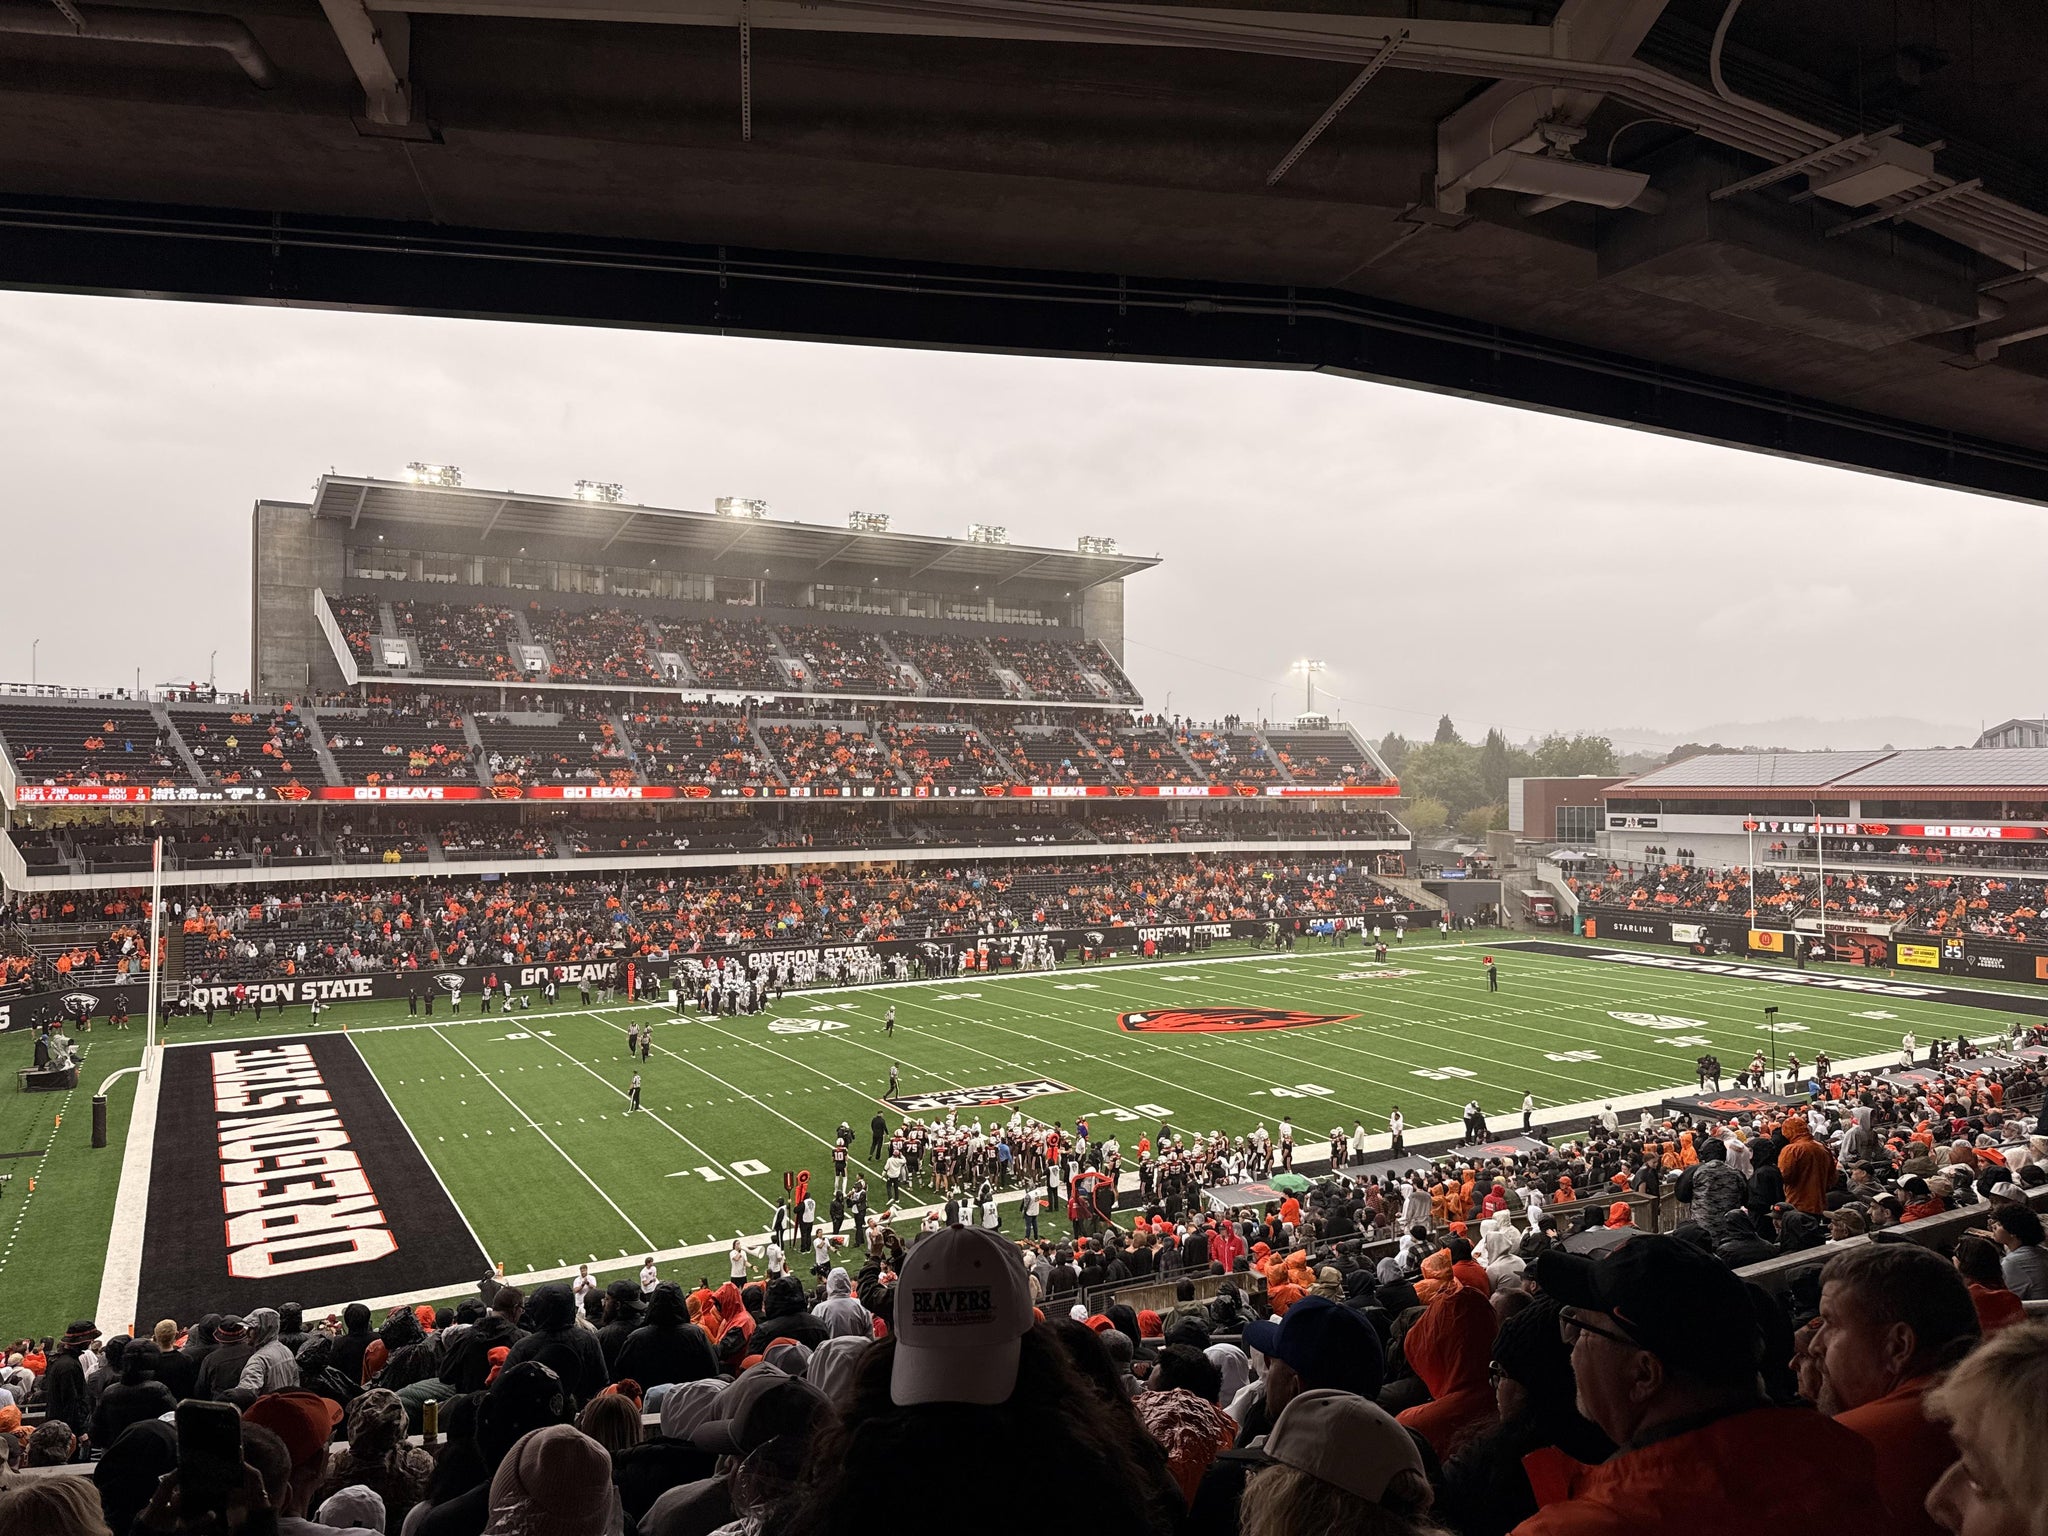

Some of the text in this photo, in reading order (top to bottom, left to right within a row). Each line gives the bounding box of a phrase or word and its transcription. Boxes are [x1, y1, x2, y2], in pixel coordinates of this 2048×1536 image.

[354, 787, 444, 799] GO BEAVS
[563, 786, 642, 798] GO BEAVS
[1924, 826, 2001, 838] GO BEAVS
[1613, 922, 1654, 934] STARLINK
[1944, 945, 1962, 958] 25
[1589, 954, 1948, 995] BEAVERS
[302, 978, 373, 1000] STATE
[212, 1044, 332, 1112] STATE
[1409, 1066, 1478, 1080] 50
[1269, 1083, 1336, 1098] 40
[1099, 1103, 1175, 1122] 30
[906, 1144, 918, 1153] 75
[834, 1152, 844, 1161] 10
[693, 1159, 771, 1182] 10
[217, 1108, 399, 1278] OREGON
[912, 1290, 991, 1312] BEAVERS
